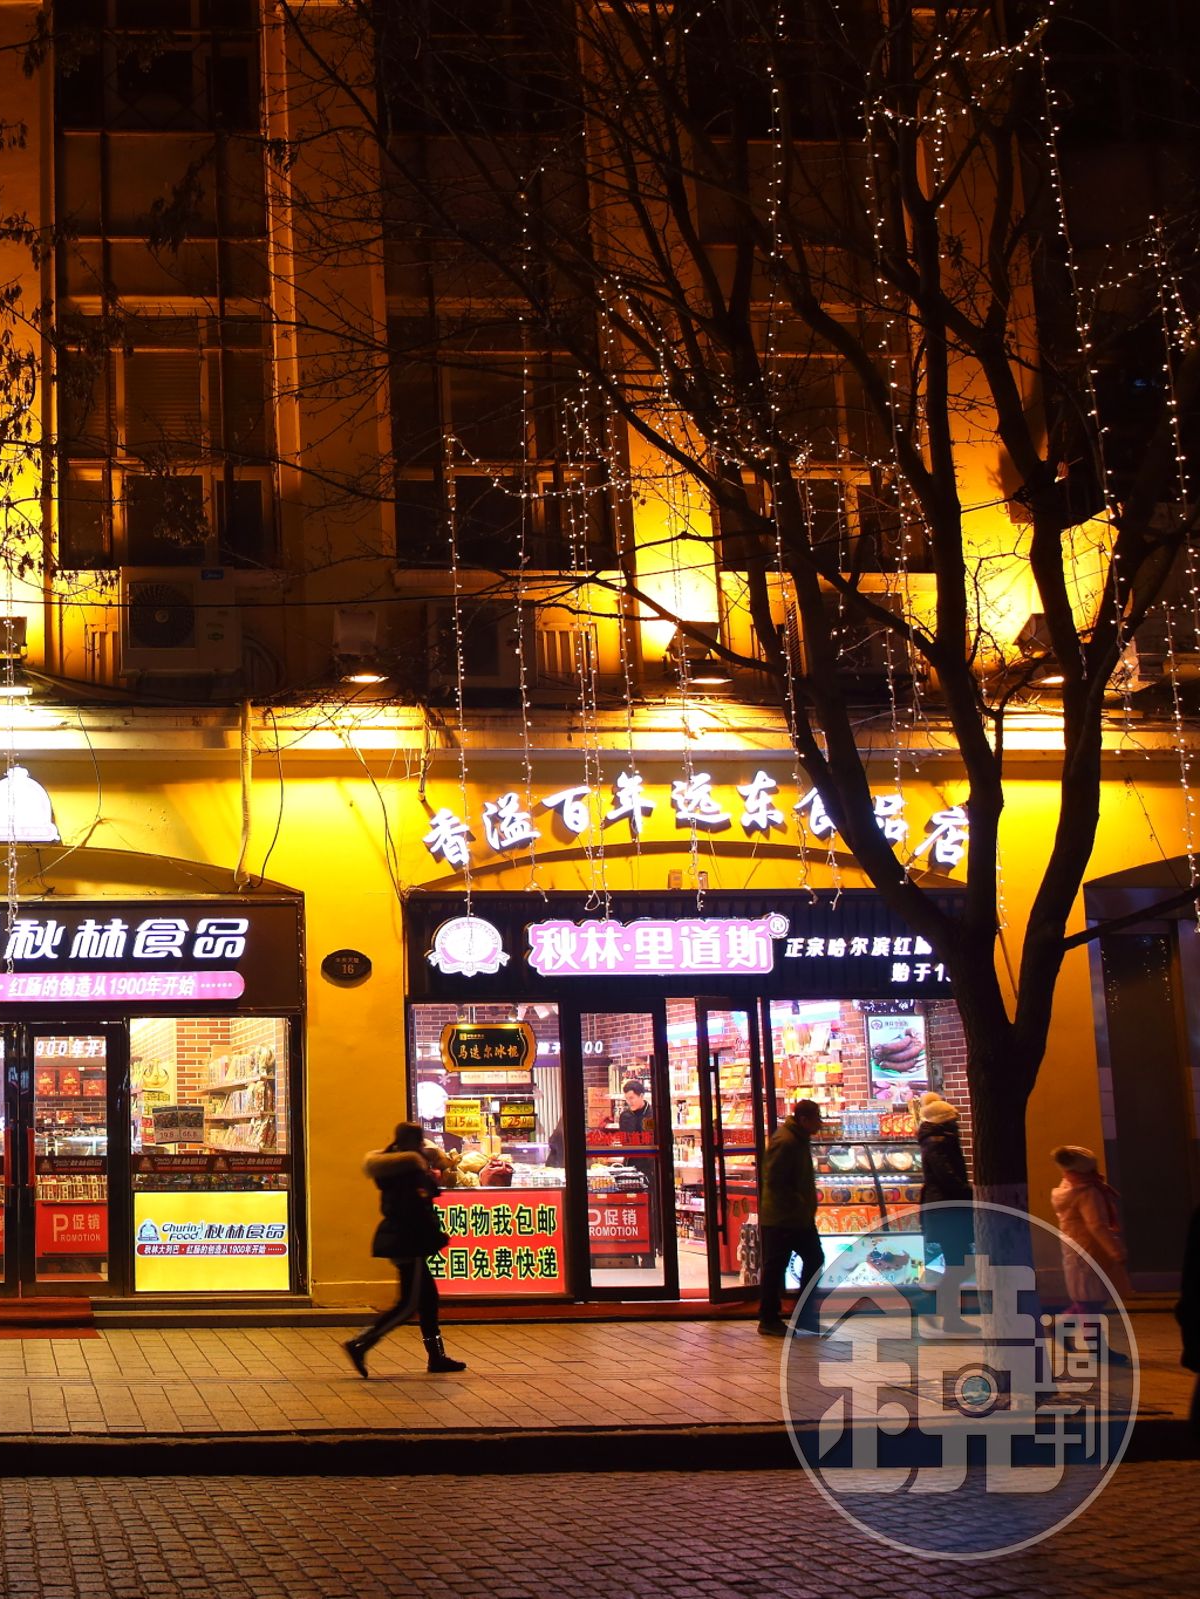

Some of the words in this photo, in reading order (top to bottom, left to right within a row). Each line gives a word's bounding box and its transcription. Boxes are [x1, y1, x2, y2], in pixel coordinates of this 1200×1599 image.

[3, 918, 249, 959] 秋林食品
[891, 962, 951, 982] 始于1
[36, 1039, 106, 1058] 900年开
[204, 1224, 286, 1239] 秋林食品
[427, 1247, 558, 1280] 全国免费快递
